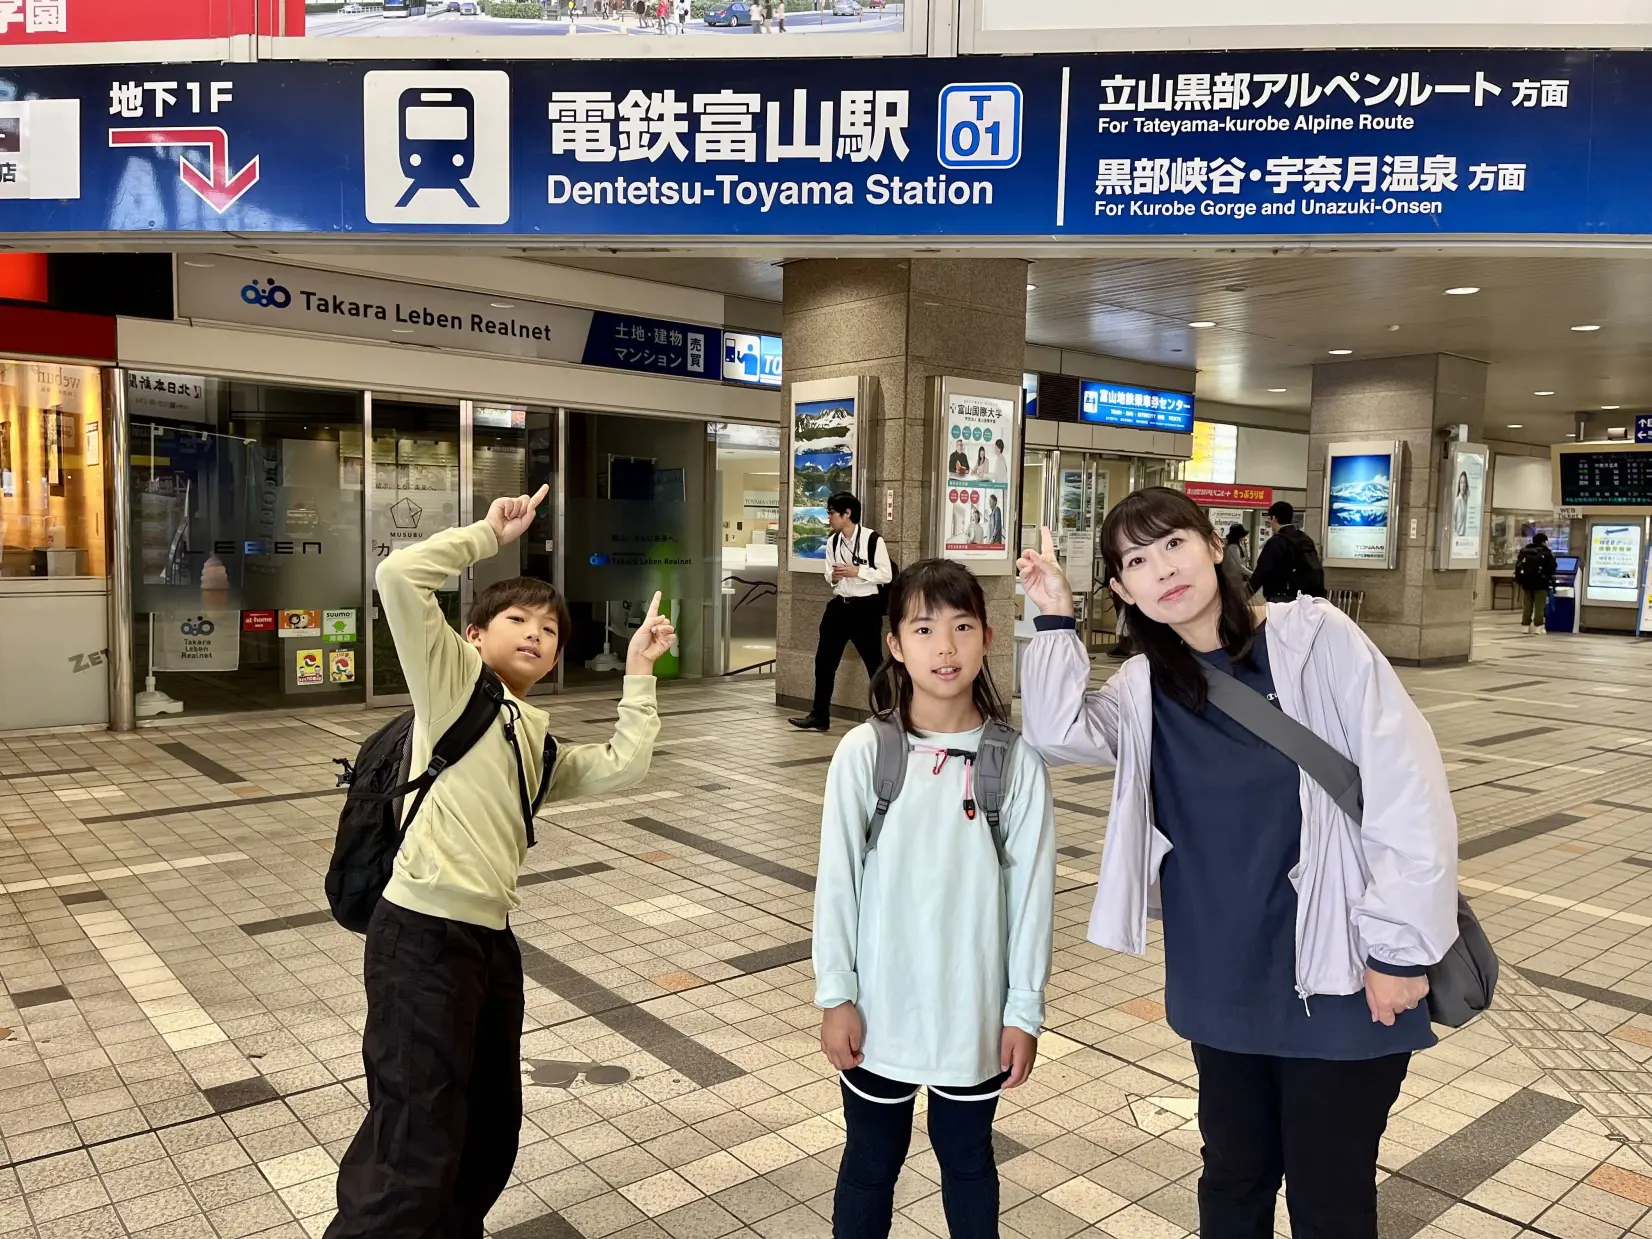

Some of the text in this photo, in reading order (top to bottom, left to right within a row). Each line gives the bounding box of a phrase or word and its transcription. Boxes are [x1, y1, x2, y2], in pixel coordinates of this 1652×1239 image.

[1099, 72, 1570, 111] 立山黒部アルペンルート 方面
[969, 95, 991, 121] T
[548, 88, 910, 163] 電鉄富山駅
[1099, 114, 1415, 137] For Tateyama-kurobe Alpine Route
[1095, 155, 1527, 195] 黒部峡谷・宇奈月温泉 方面
[548, 174, 994, 213] Dentetsu-Toyama Station
[1095, 198, 1442, 219] For Kurobe Gorge and Unazuki-Onsen
[299, 290, 551, 342] Takara Leben Realnet
[615, 322, 683, 347] 土地・建物
[614, 347, 682, 368] マンション
[690, 337, 702, 368] 売買
[957, 404, 1002, 419] 富山国際大学
[1233, 489, 1265, 499] きっぷうりば
[640, 557, 662, 565] Leben
[664, 557, 692, 565] Realnet
[184, 638, 211, 646] Takara
